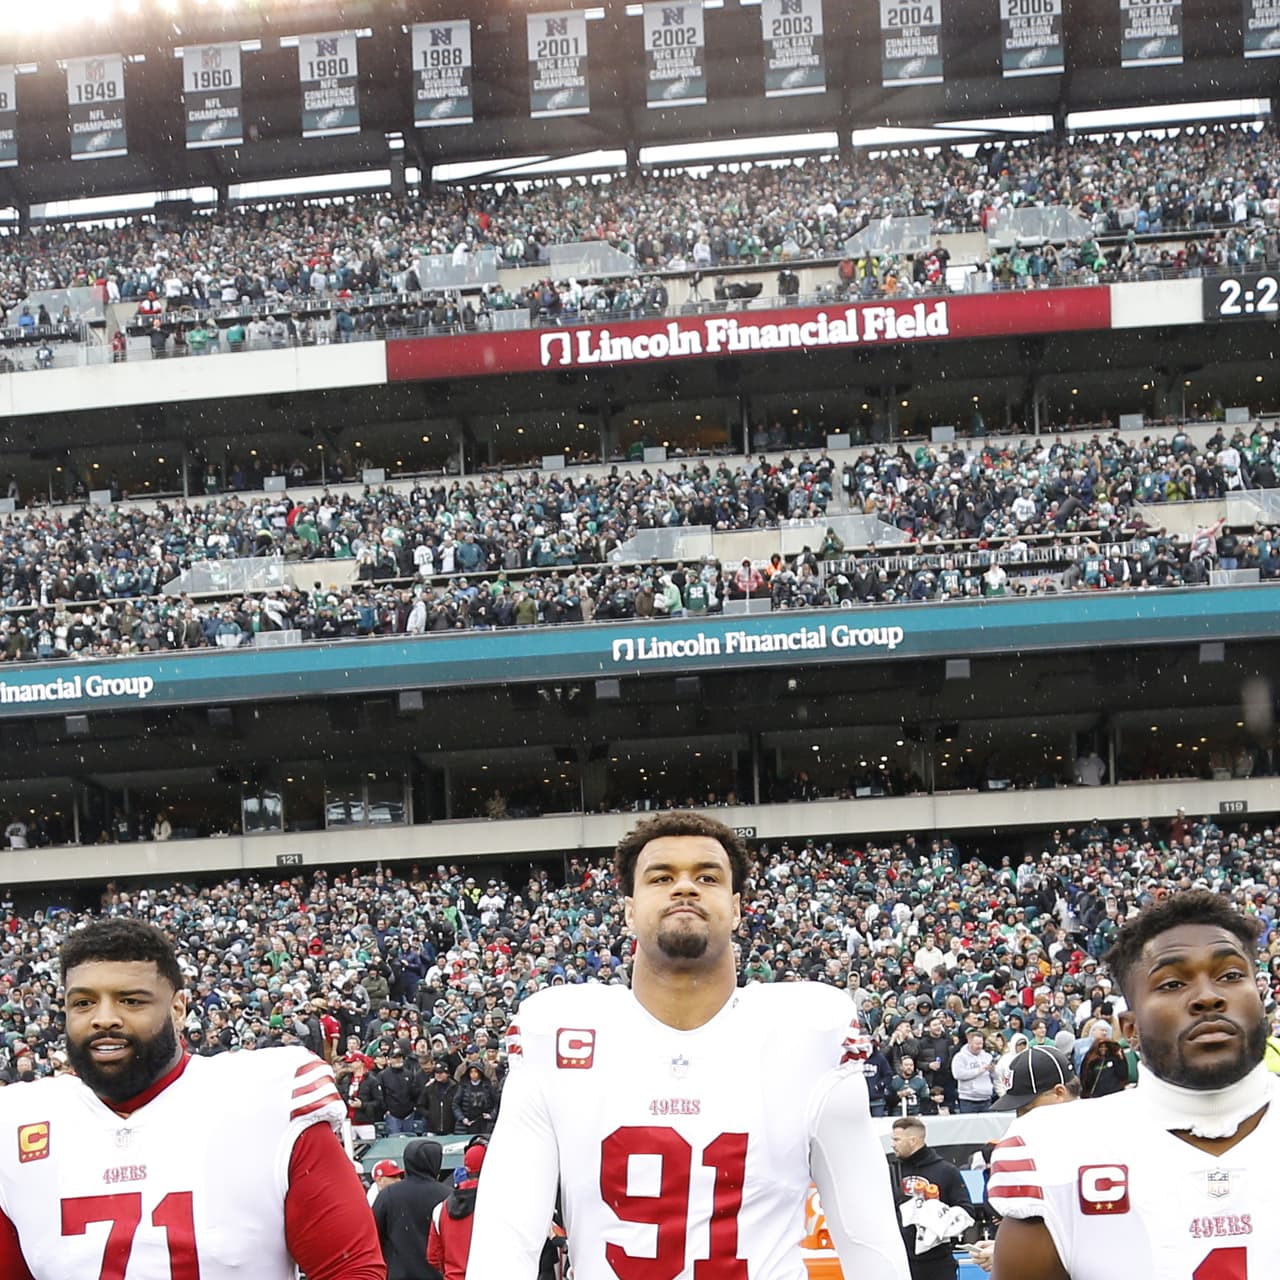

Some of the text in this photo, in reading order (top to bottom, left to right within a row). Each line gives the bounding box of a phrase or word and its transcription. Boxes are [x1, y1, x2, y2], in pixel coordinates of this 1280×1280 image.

[888, 6, 933, 26] 2004
[1129, 6, 1173, 18] NFC EAST
[772, 16, 813, 37] 2003
[1009, 16, 1054, 28] NFC EAST
[1132, 16, 1170, 28] DIVISION
[652, 27, 696, 47] 2002
[1124, 25, 1178, 39] CHAMPIONS
[537, 37, 579, 58] 2001
[792, 36, 814, 46] EAST
[1006, 34, 1059, 49] CHAMPIONS
[422, 48, 462, 68] 1988
[673, 47, 696, 58] EAST
[886, 44, 938, 59] CHAMPIONS
[308, 58, 349, 78] 1980
[557, 57, 580, 68] EAST
[769, 55, 819, 69] CHAMPIONS
[193, 69, 232, 89] 1960
[441, 68, 464, 78] EAST
[650, 66, 702, 81] CHAMPIONS
[76, 81, 117, 101] 1949
[533, 76, 585, 91] CHAMPIONS
[417, 86, 469, 100] CHAMPIONS
[205, 98, 220, 108] NFL
[305, 95, 356, 110] CHAMPIONS
[89, 110, 106, 121] NFL
[188, 107, 239, 121] CHAMPIONS
[73, 118, 123, 133] CHAMPIONS
[576, 301, 949, 364] Lincoln Financial Field
[637, 625, 903, 660] Lincoln Financial Group
[84, 675, 153, 698] Group
[1224, 802, 1244, 812] 119
[281, 855, 299, 864] 121
[649, 1098, 701, 1115] 49ERS
[102, 1165, 147, 1184] 49ERS
[1189, 1214, 1252, 1238] 49ERS
